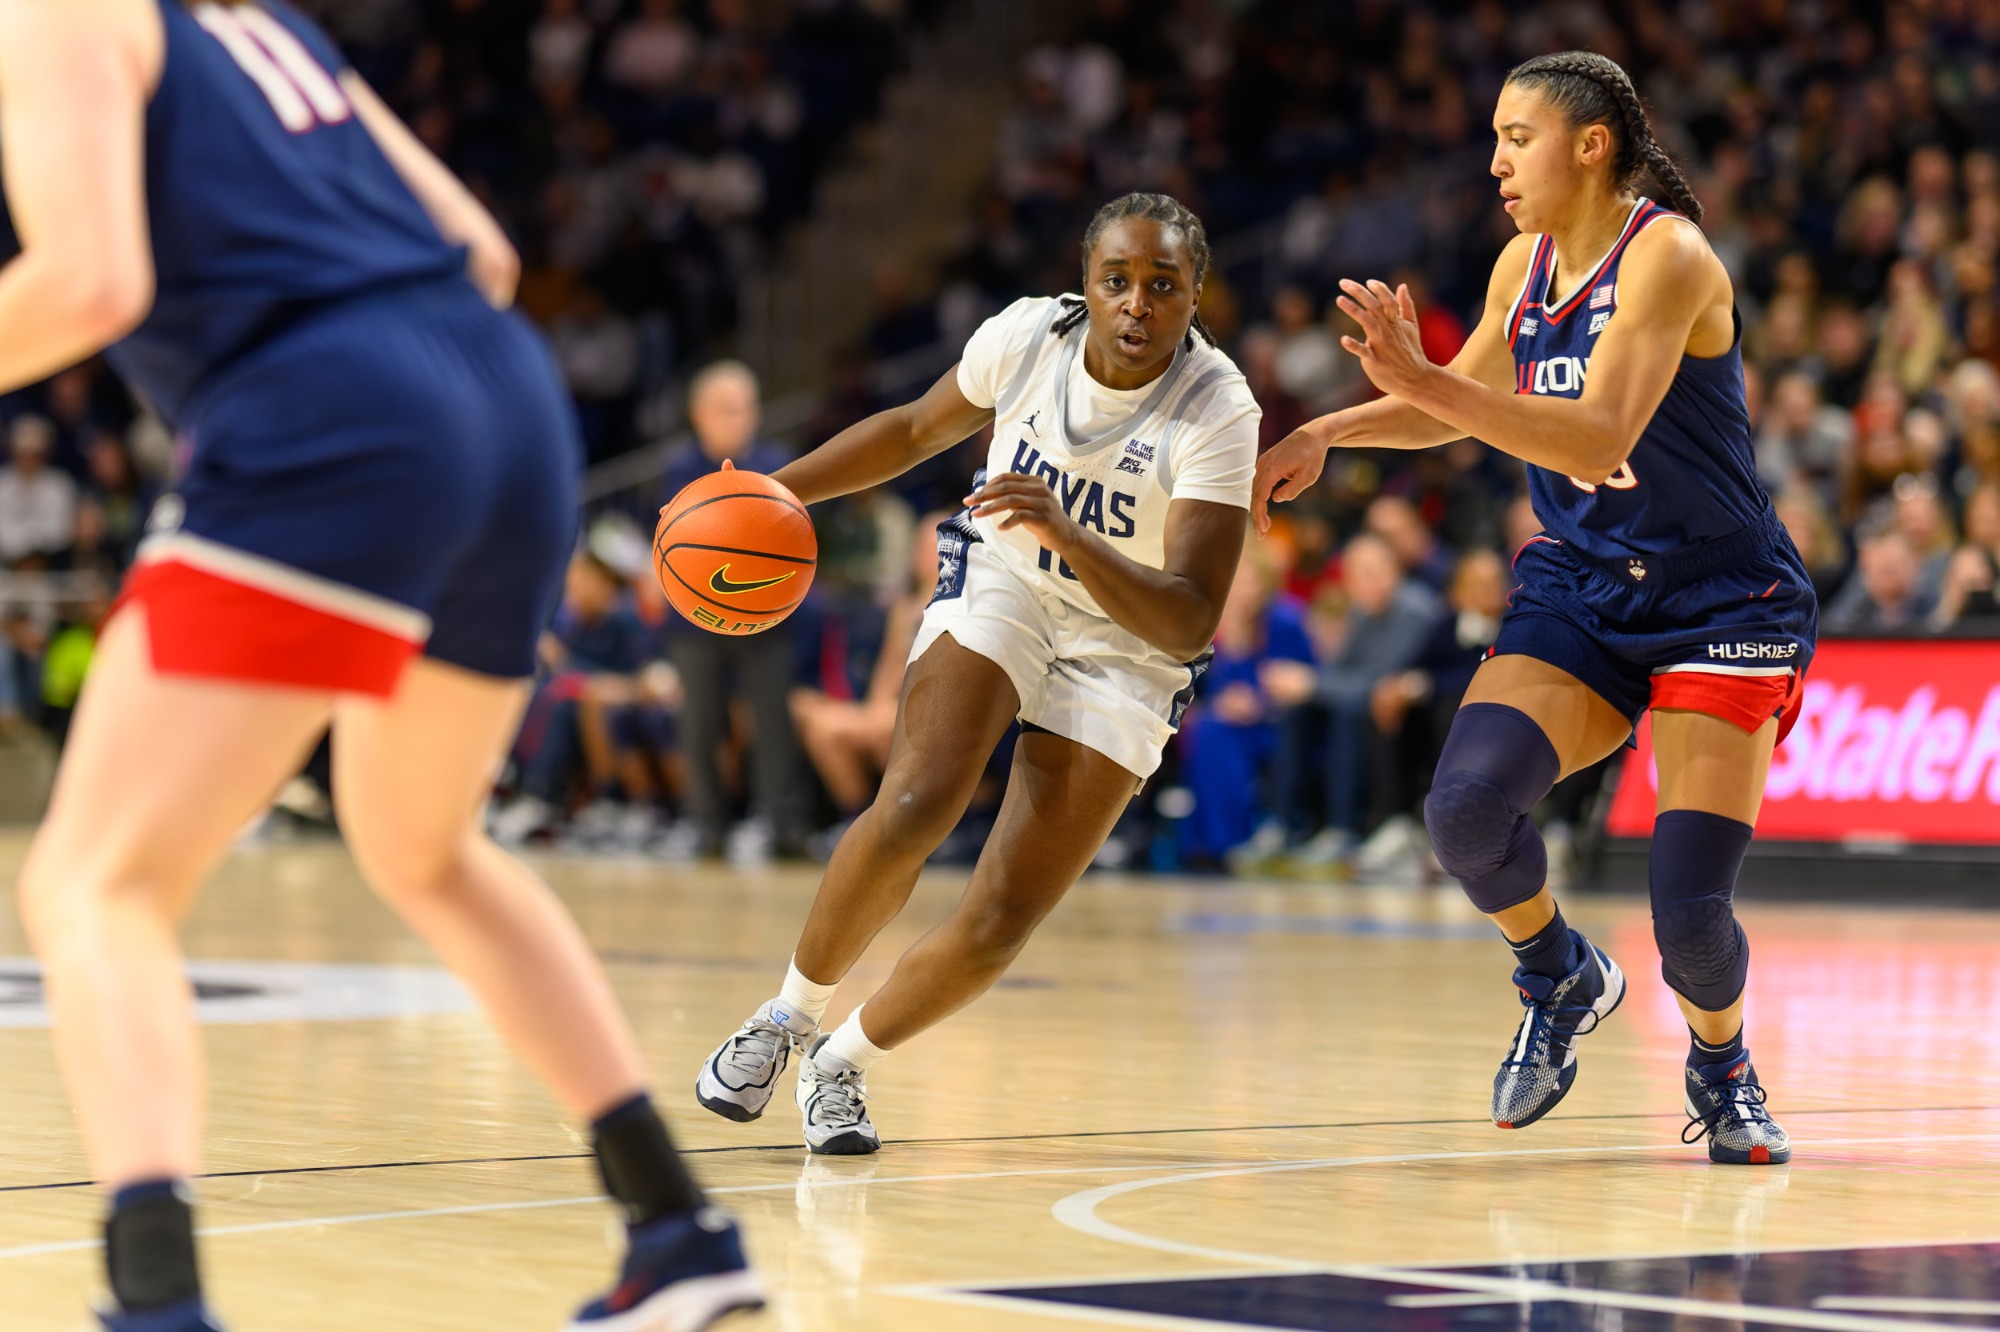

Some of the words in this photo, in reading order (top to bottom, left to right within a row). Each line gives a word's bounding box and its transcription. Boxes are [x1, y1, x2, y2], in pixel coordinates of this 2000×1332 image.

[1591, 311, 1610, 323] BIG
[1124, 445, 1154, 463] CHANGE
[1129, 438, 1140, 449] BE
[1140, 443, 1155, 455] THE
[1117, 462, 1146, 475] EAST
[1121, 456, 1142, 467] BIG
[690, 604, 782, 633] ELITE
[1708, 642, 1798, 659] HUSKIES
[1764, 680, 1968, 801] State
